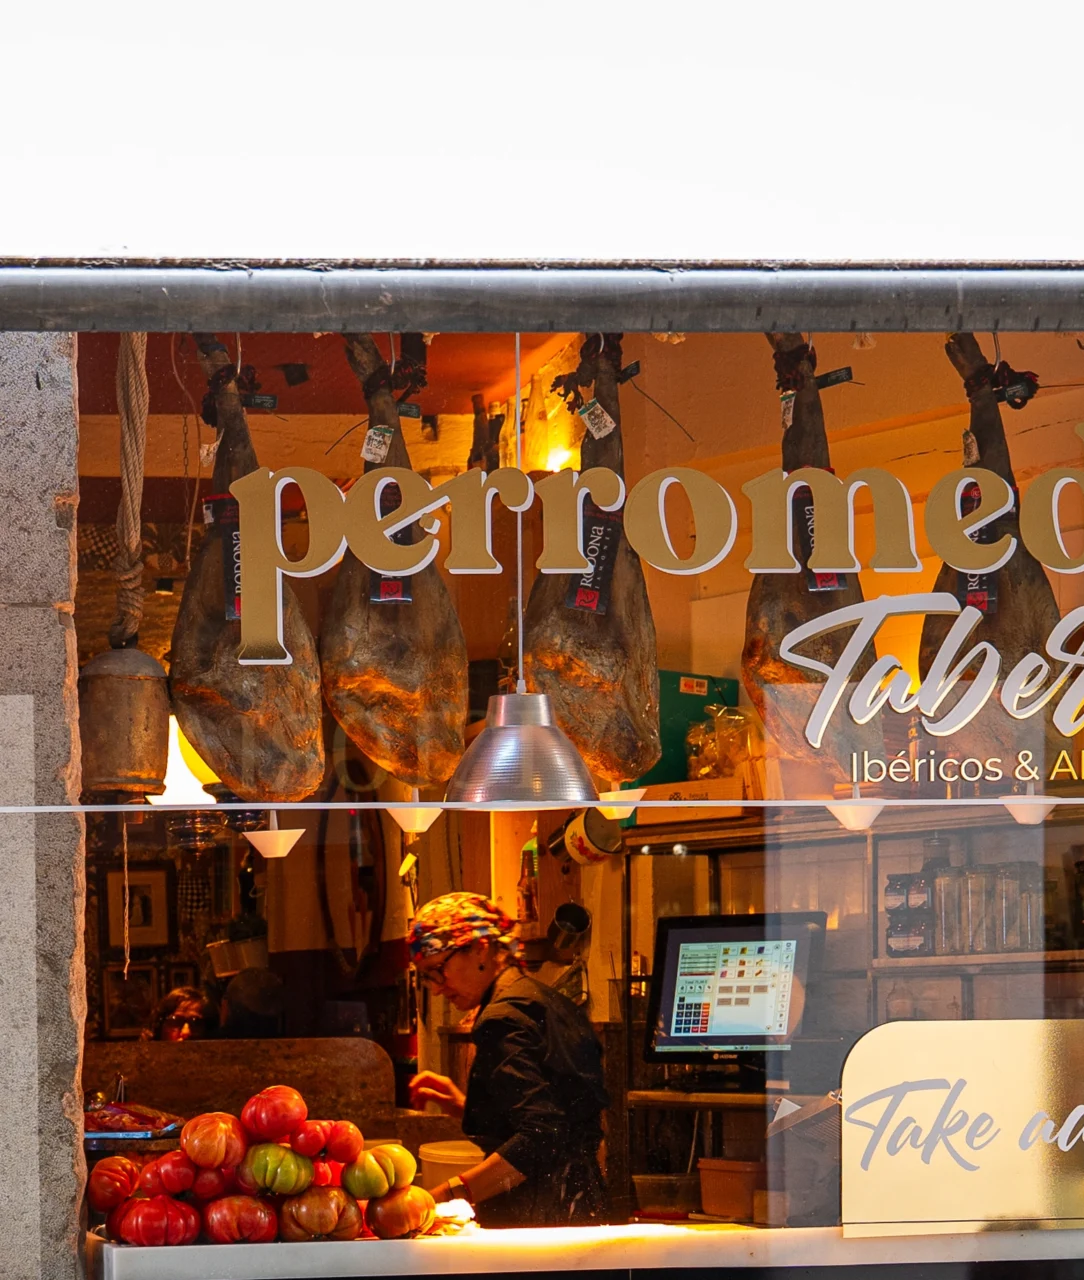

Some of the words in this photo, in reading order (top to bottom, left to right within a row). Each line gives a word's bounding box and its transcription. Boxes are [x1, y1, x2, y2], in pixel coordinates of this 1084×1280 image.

[851, 748, 1004, 784] Ibéricos
[1014, 751, 1041, 781] &
[843, 1077, 1001, 1173] Take
